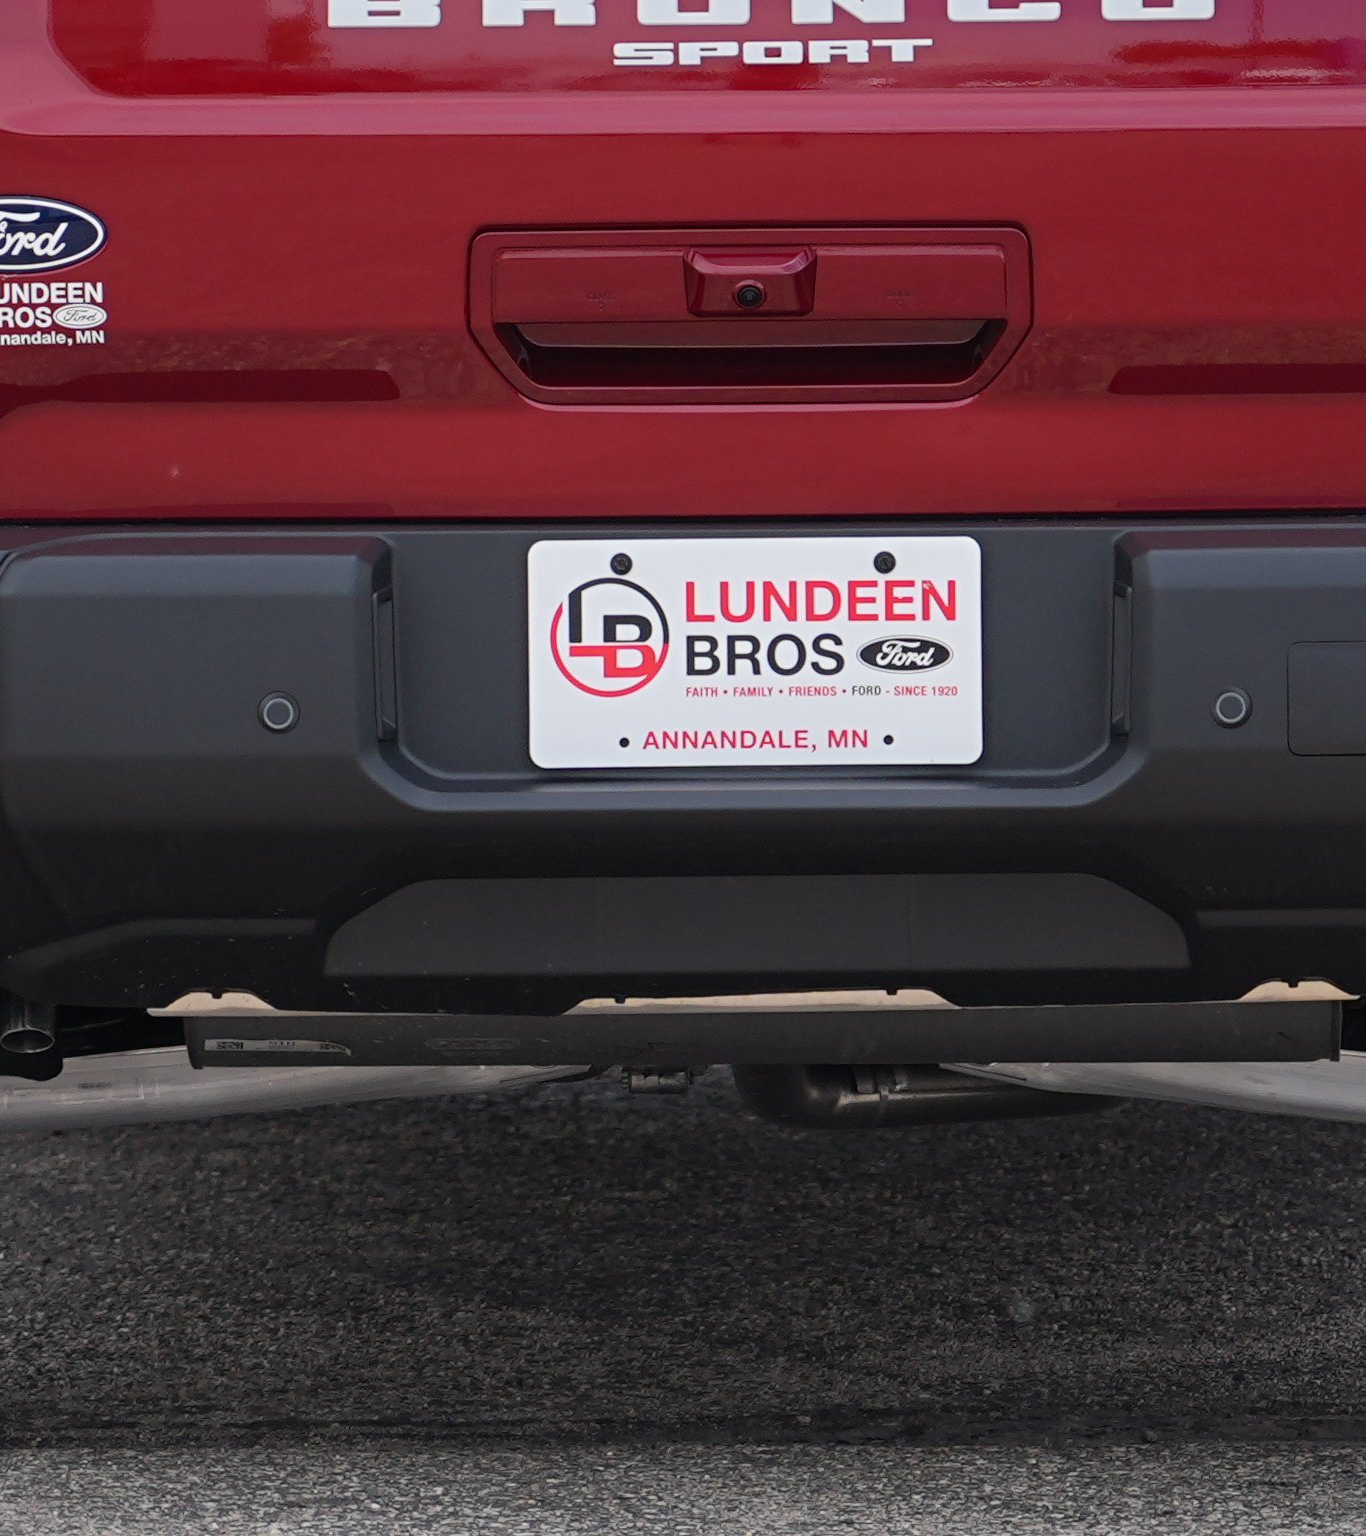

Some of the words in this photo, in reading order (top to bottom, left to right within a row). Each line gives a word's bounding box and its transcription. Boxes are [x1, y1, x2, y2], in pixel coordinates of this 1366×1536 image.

[612, 38, 933, 67] SPORT
[62, 310, 100, 324] Ford
[75, 329, 105, 344] MN
[685, 579, 956, 623] LUNDEEN
[686, 632, 845, 677] BROS
[875, 640, 934, 667] Ford
[685, 686, 718, 697] FAITH
[733, 686, 773, 697] FAMILY
[788, 685, 837, 696] FRIENDS
[851, 685, 881, 696] FORD
[893, 685, 927, 696] SINCE
[932, 685, 958, 696] 1920
[642, 729, 817, 753] ANNANDALE,
[828, 729, 869, 748] MN
